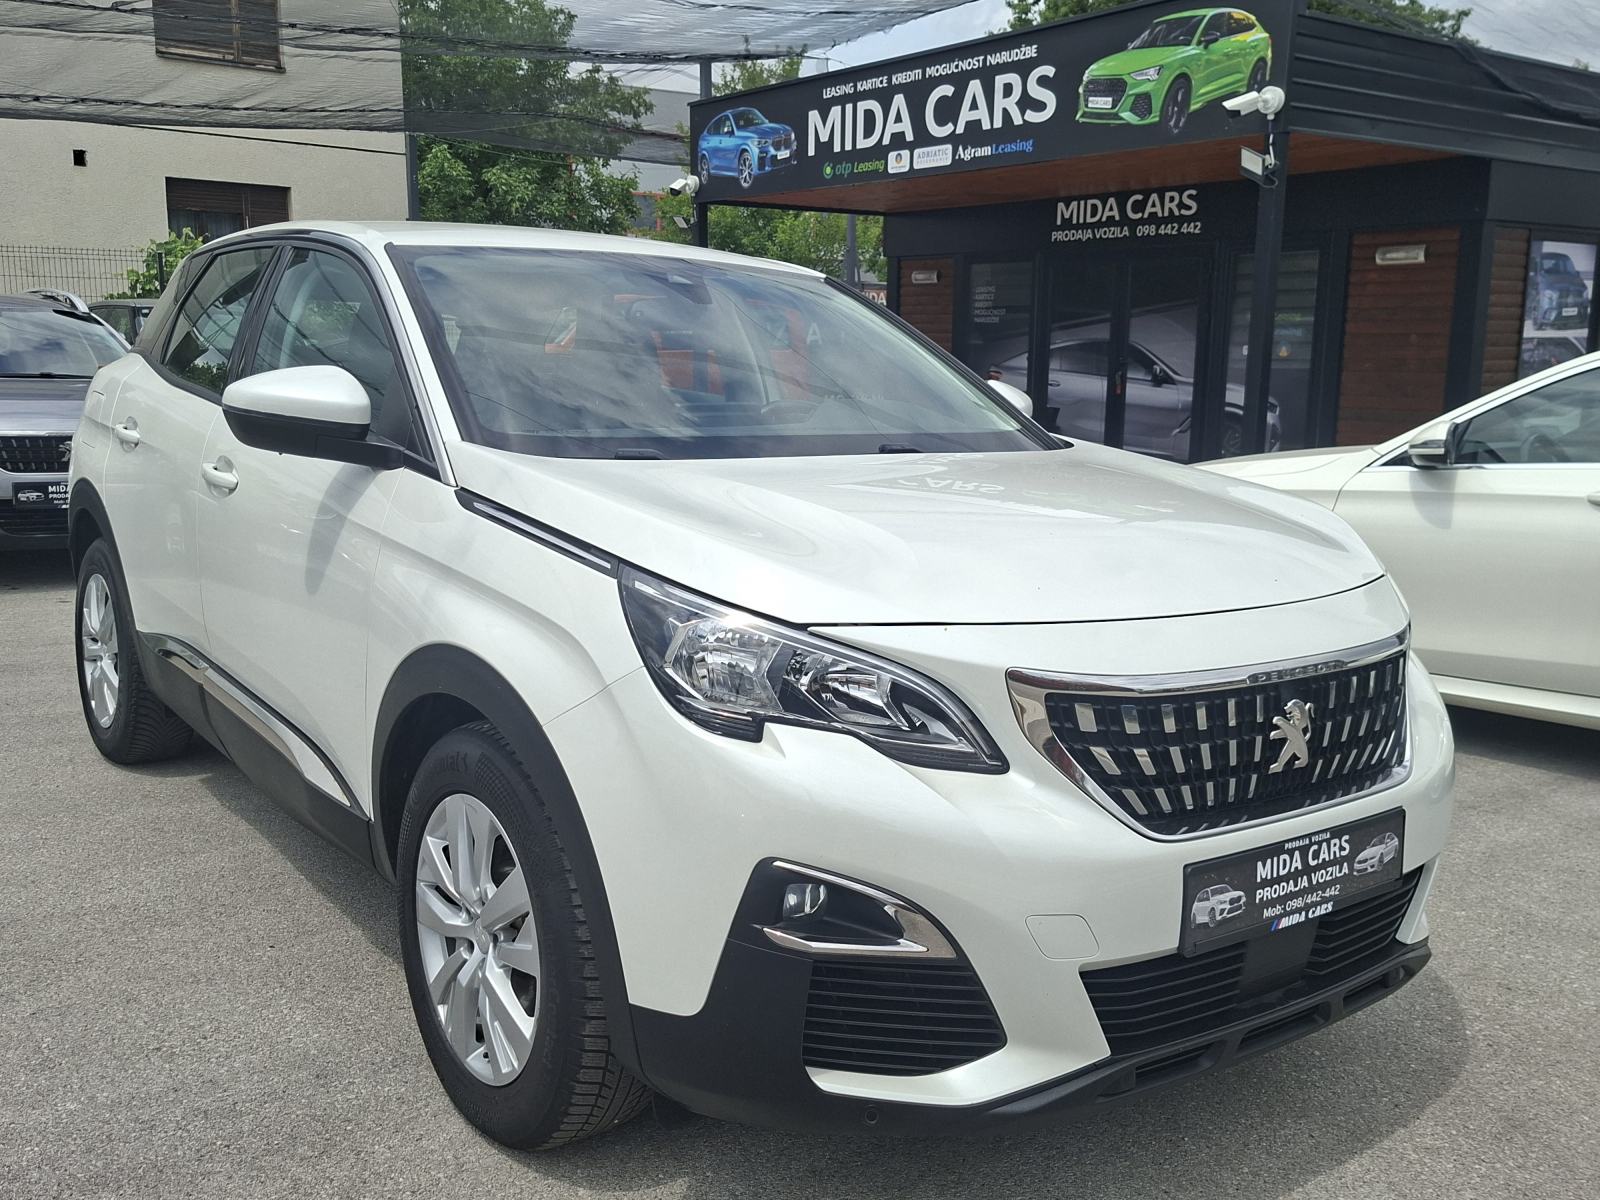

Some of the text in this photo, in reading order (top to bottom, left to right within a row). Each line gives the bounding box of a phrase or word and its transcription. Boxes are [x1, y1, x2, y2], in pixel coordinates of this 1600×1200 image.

[823, 44, 1038, 99] LEASING KARTICE KREDITI MOGUĆNOST NARUDŽBE
[807, 65, 1057, 157] MIDA CARS
[916, 149, 949, 160] ADRIATIC
[955, 138, 1033, 162] AgramLeasing
[835, 157, 885, 177] otp Leasing
[1056, 189, 1198, 225] MIDA CARS
[1051, 221, 1201, 242] PRODAJA VOZILA 098 442 442
[1284, 832, 1330, 850] PRODAJA VOZILA
[1256, 835, 1350, 883] MIDA CARS
[1255, 862, 1349, 904] PRODAJA VOZILA
[1263, 884, 1341, 919] Mob: 098/442-442
[1279, 902, 1334, 929] MIDA CARS
